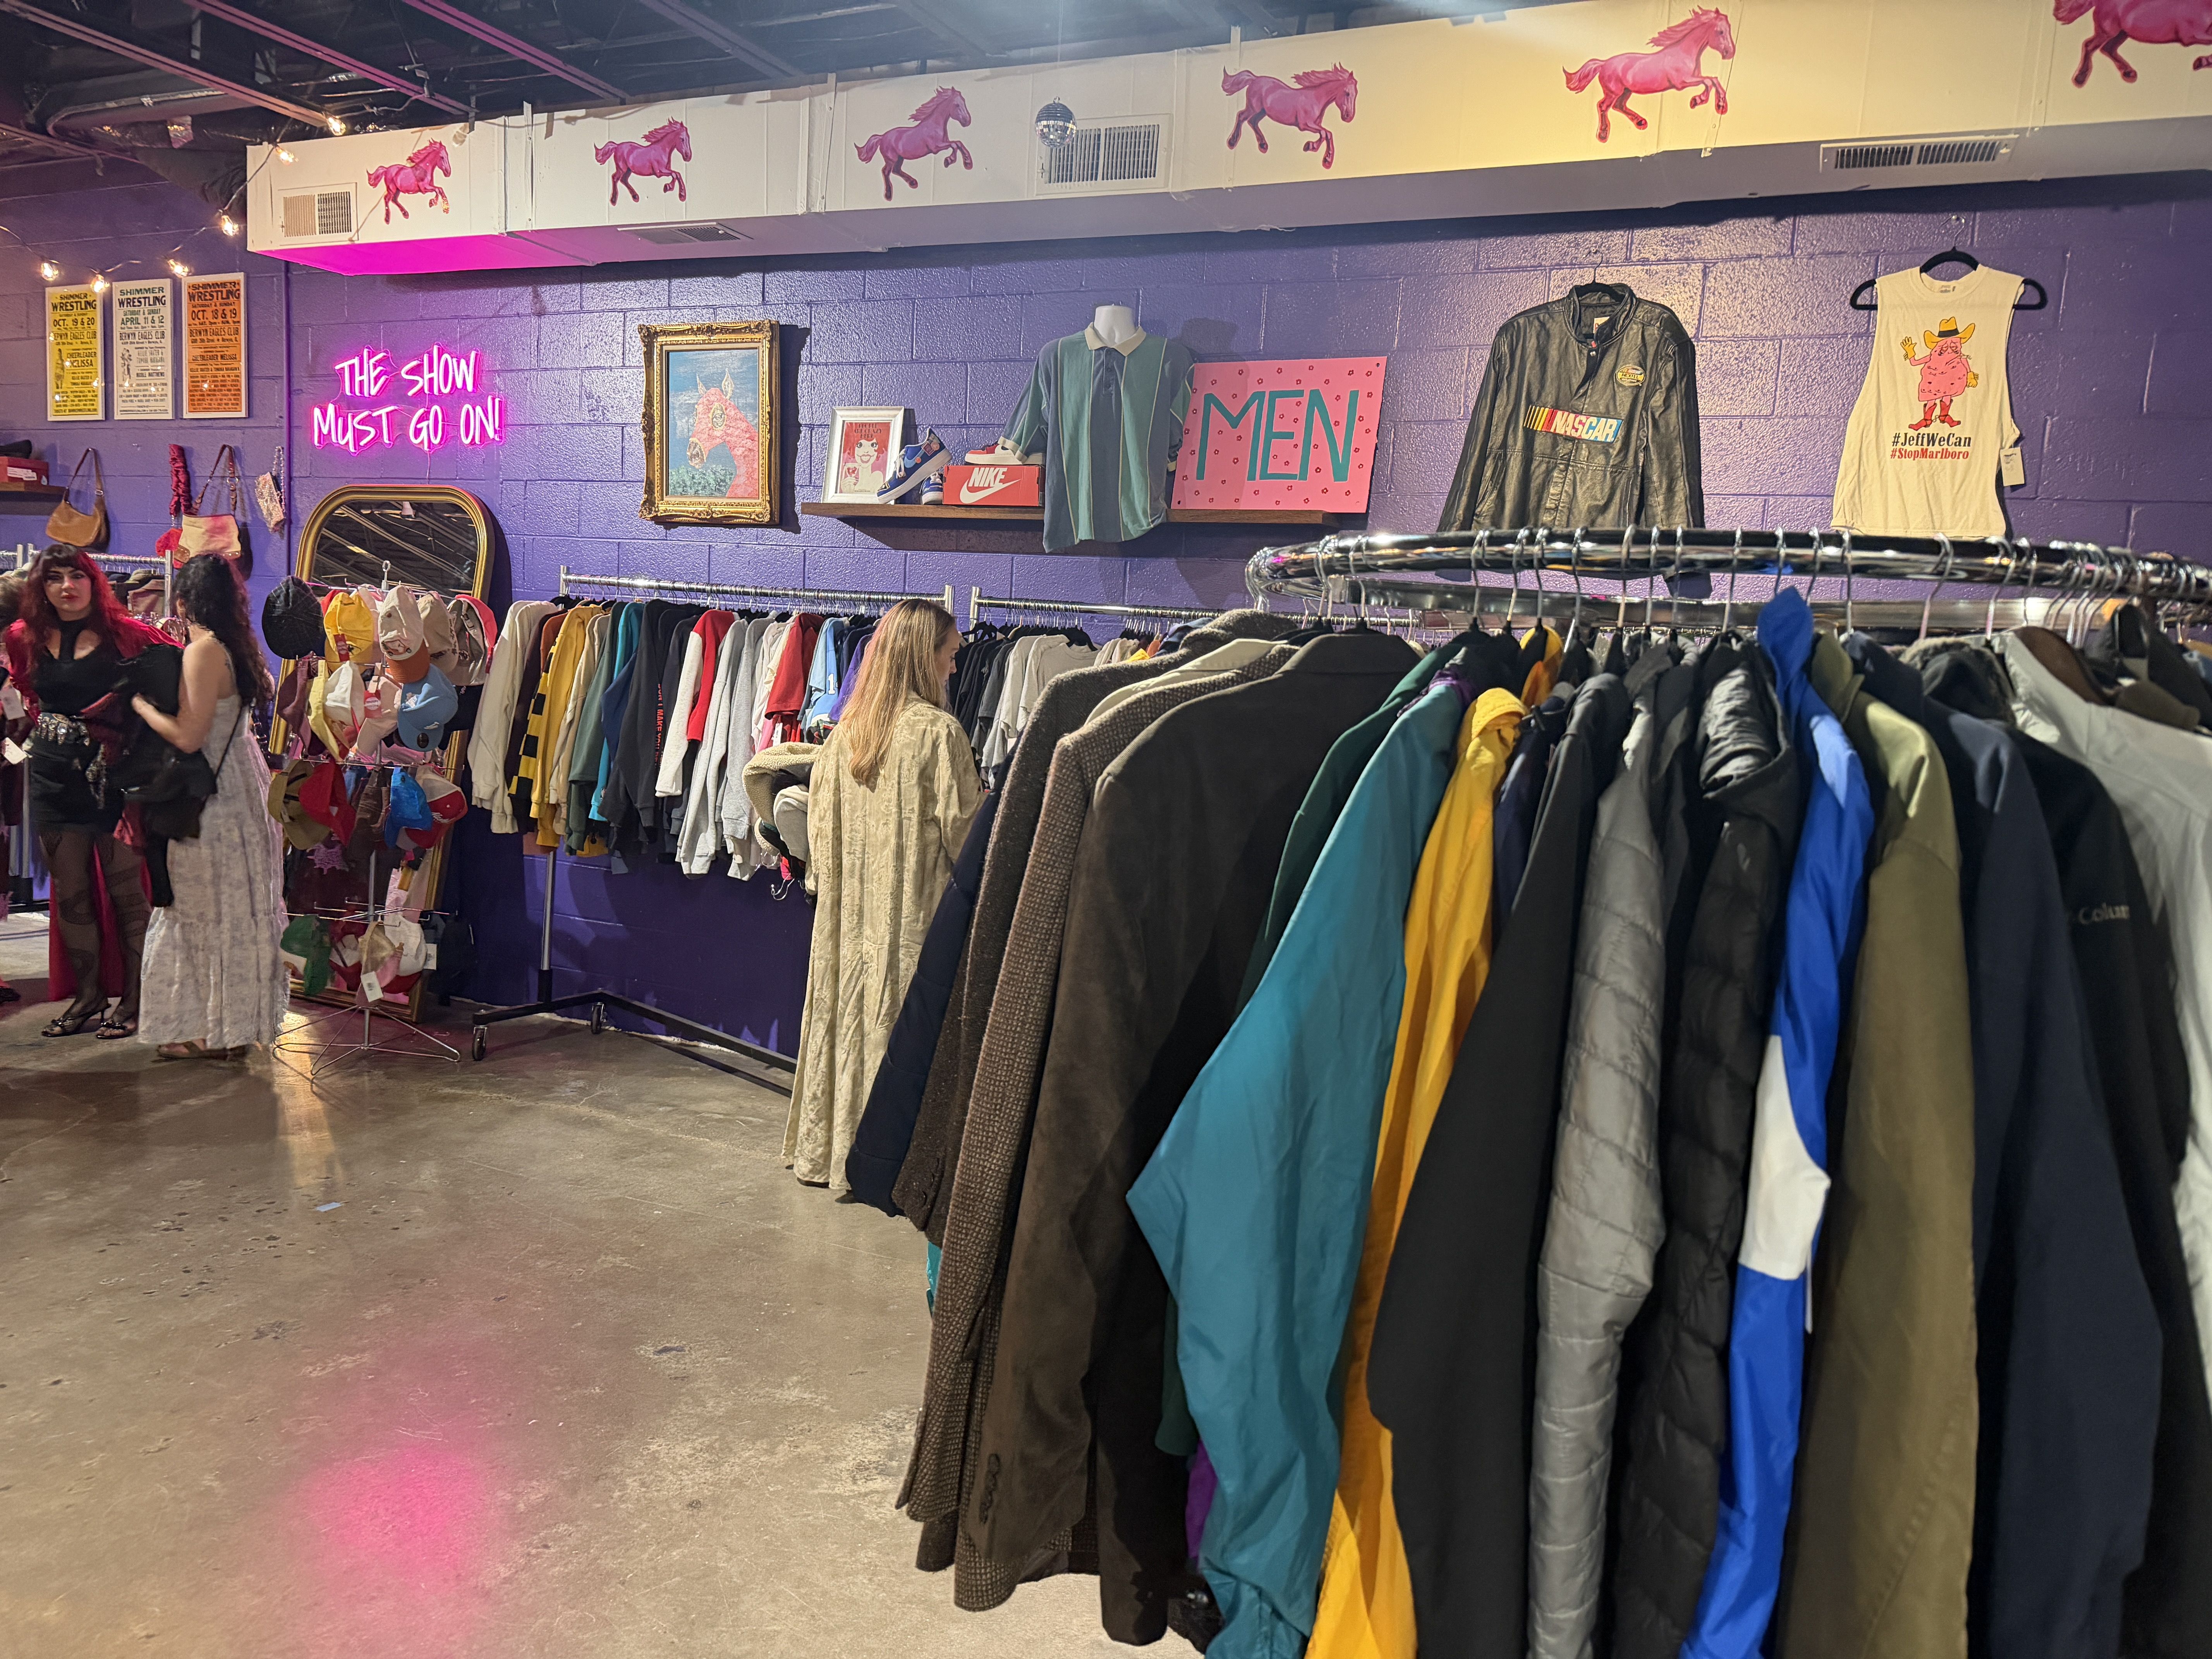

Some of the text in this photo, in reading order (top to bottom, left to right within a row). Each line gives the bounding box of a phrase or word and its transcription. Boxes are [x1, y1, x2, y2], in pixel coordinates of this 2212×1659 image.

[120, 287, 164, 296] SHIMMER
[192, 282, 237, 290] SHIMMER
[118, 295, 166, 308] WRESTLING
[188, 289, 240, 302] WRESTLING
[51, 299, 96, 312] WRESTLING
[121, 315, 164, 325] APRIL 11 & 12
[191, 308, 237, 321] OCT. 18 & 19
[53, 317, 95, 327] OCT. 19 & 20
[138, 331, 153, 340] EAGLES
[155, 331, 165, 339] CLUB
[227, 327, 239, 336] CLUB
[335, 345, 478, 397] THE SHOW
[409, 404, 443, 451] GO
[460, 395, 503, 444] ON!
[1550, 410, 1617, 442] NASCAR
[1196, 389, 1359, 482] MEN
[1892, 433, 1972, 447] #JeffWeCan
[1890, 447, 1969, 461] #StopMarlboro
[968, 467, 1008, 487] NIKE
[828, 673, 838, 694] 1
